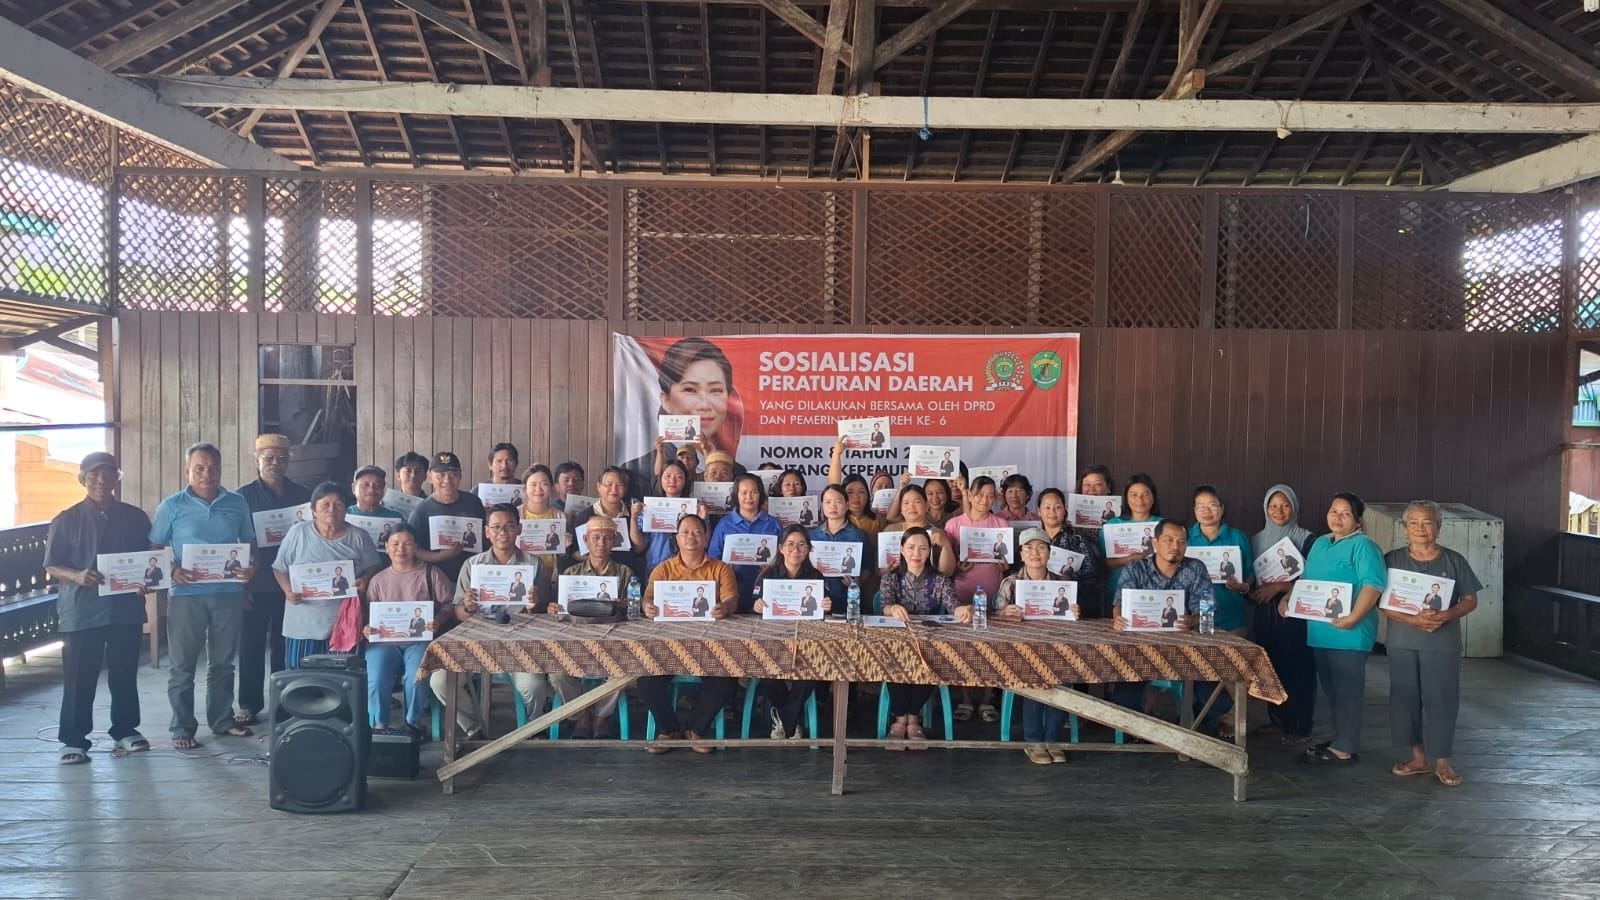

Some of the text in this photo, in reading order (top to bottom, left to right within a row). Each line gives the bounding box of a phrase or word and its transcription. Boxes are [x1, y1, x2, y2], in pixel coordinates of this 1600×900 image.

[759, 351, 914, 372] SOSIALISASI
[759, 375, 973, 392] PERATURAN DAERAH
[760, 400, 996, 411] YANG DILAKUKAN BERSAMA OLEH DPRD
[760, 415, 786, 425] DAN
[940, 415, 947, 425] 6
[760, 446, 824, 459] NOMOR
